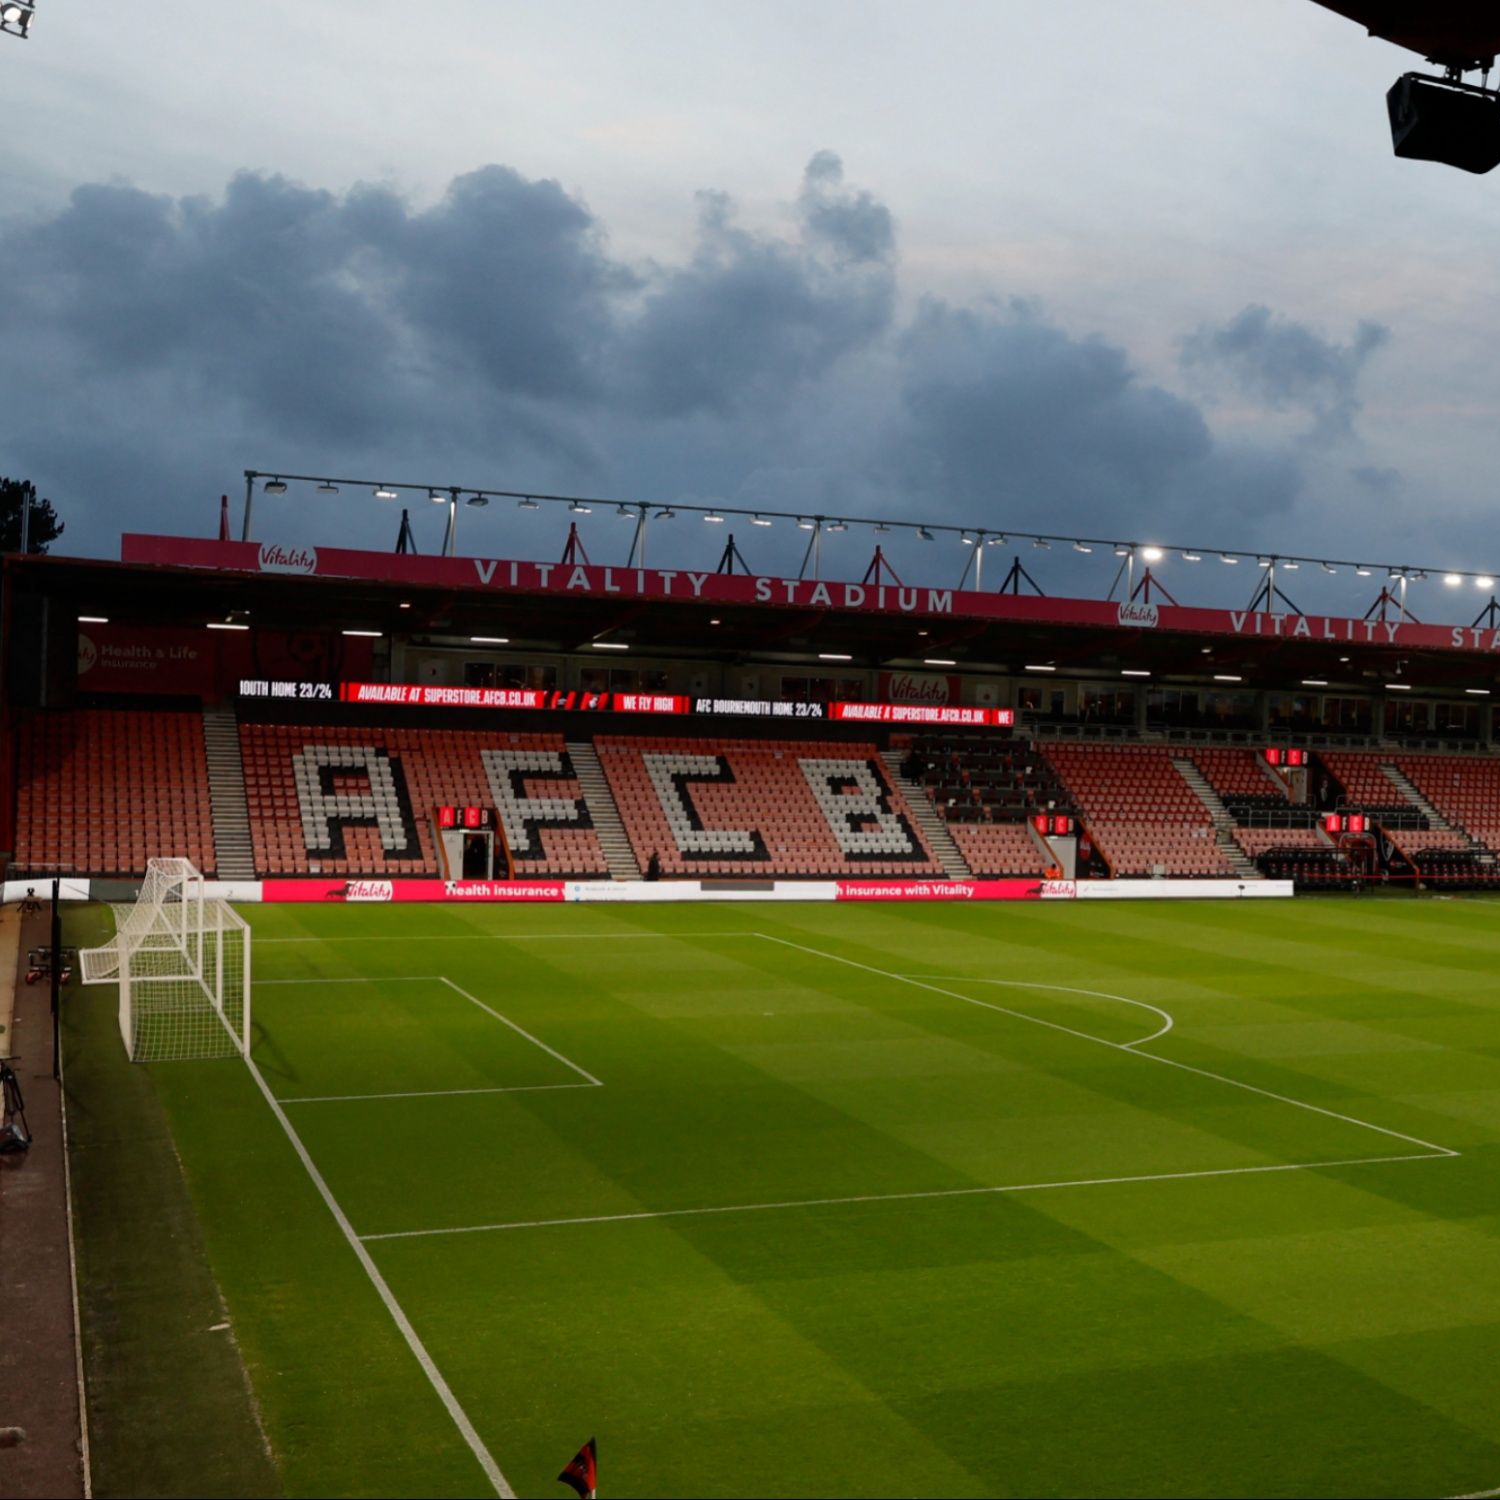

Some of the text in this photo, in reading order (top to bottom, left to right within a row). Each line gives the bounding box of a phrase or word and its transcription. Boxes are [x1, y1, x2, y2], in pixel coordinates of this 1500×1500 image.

[260, 546, 316, 572] Vitality
[474, 560, 953, 613] VITALITY STADIUM
[1119, 602, 1158, 625] Vitality
[1230, 611, 1400, 643] VITALITY
[101, 644, 150, 659] Health
[168, 646, 198, 661] Life
[271, 682, 298, 698] HOME
[299, 682, 333, 700] 23/24
[357, 685, 406, 701] AVAILABLE
[408, 687, 422, 701] AT
[890, 673, 949, 704] Vitality
[623, 695, 674, 712] WE FLY HIGH
[696, 698, 823, 718] AFC BOURNEMOUTH HOME 23/24
[841, 703, 883, 719] AVAILABLE
[346, 880, 393, 900] Vitality
[445, 883, 490, 897] Health
[493, 883, 559, 897] insurance
[846, 885, 901, 897] insurance
[904, 885, 930, 897] with
[931, 885, 974, 899] Vitality
[1040, 881, 1075, 899] Vitality
